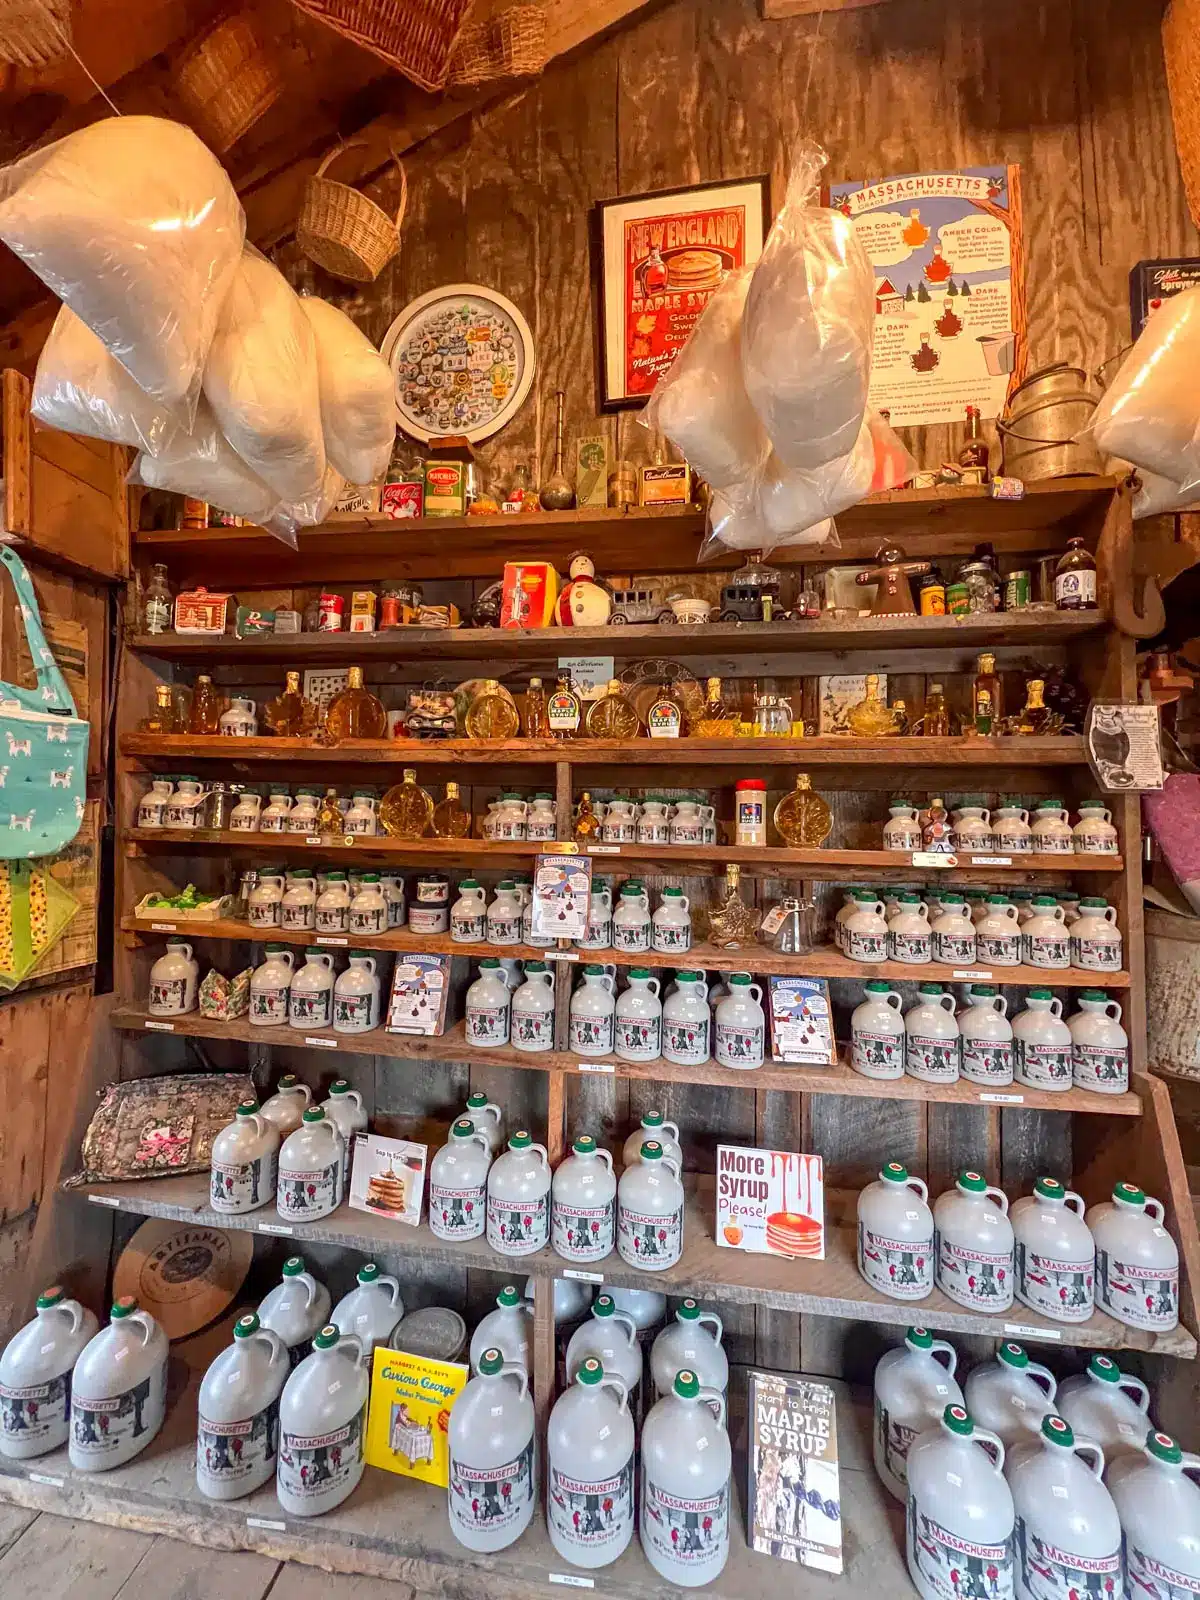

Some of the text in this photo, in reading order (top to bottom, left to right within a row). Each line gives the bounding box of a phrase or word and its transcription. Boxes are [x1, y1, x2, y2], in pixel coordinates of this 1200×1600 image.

[857, 178, 980, 203] MASSACHUSETTS
[631, 213, 739, 263] NEW ENGLAND
[942, 226, 1002, 237] AMBER COLOR
[632, 294, 681, 313] MAPLE
[673, 323, 697, 331] SWE
[633, 350, 669, 369] Nature's
[720, 1150, 765, 1175] More
[434, 1186, 479, 1198] MASSACHUSETTS
[719, 1173, 769, 1203] Syrup
[492, 1199, 538, 1211] MASSACHUSETTS
[558, 1205, 605, 1218] MASSACHUSETTS
[719, 1198, 767, 1220] Please!
[624, 1210, 672, 1226] MASSACHUSETTS
[875, 1237, 929, 1252] MASSACHUSETTS
[953, 1248, 1011, 1265] MASSACHUSETTS
[382, 1367, 456, 1397] Curious George
[757, 1391, 830, 1417] start to finish
[757, 1403, 830, 1438] MAPLE
[288, 1429, 349, 1448] MASSACHUSETTS
[760, 1424, 827, 1457] SYRUP
[458, 1465, 518, 1481] MASSACHUSETTS
[559, 1476, 620, 1495] MASSACHUSETTS
[656, 1491, 718, 1512] MASSACHUSETTS
[476, 1519, 494, 1527] Maple
[576, 1533, 596, 1542] Maple
[764, 1529, 825, 1553] Brian Cunningham
[932, 1523, 1004, 1559] MASSACHUSETTS
[675, 1551, 695, 1560] Maple
[1045, 1544, 1118, 1571] MASSACHUSETTS
